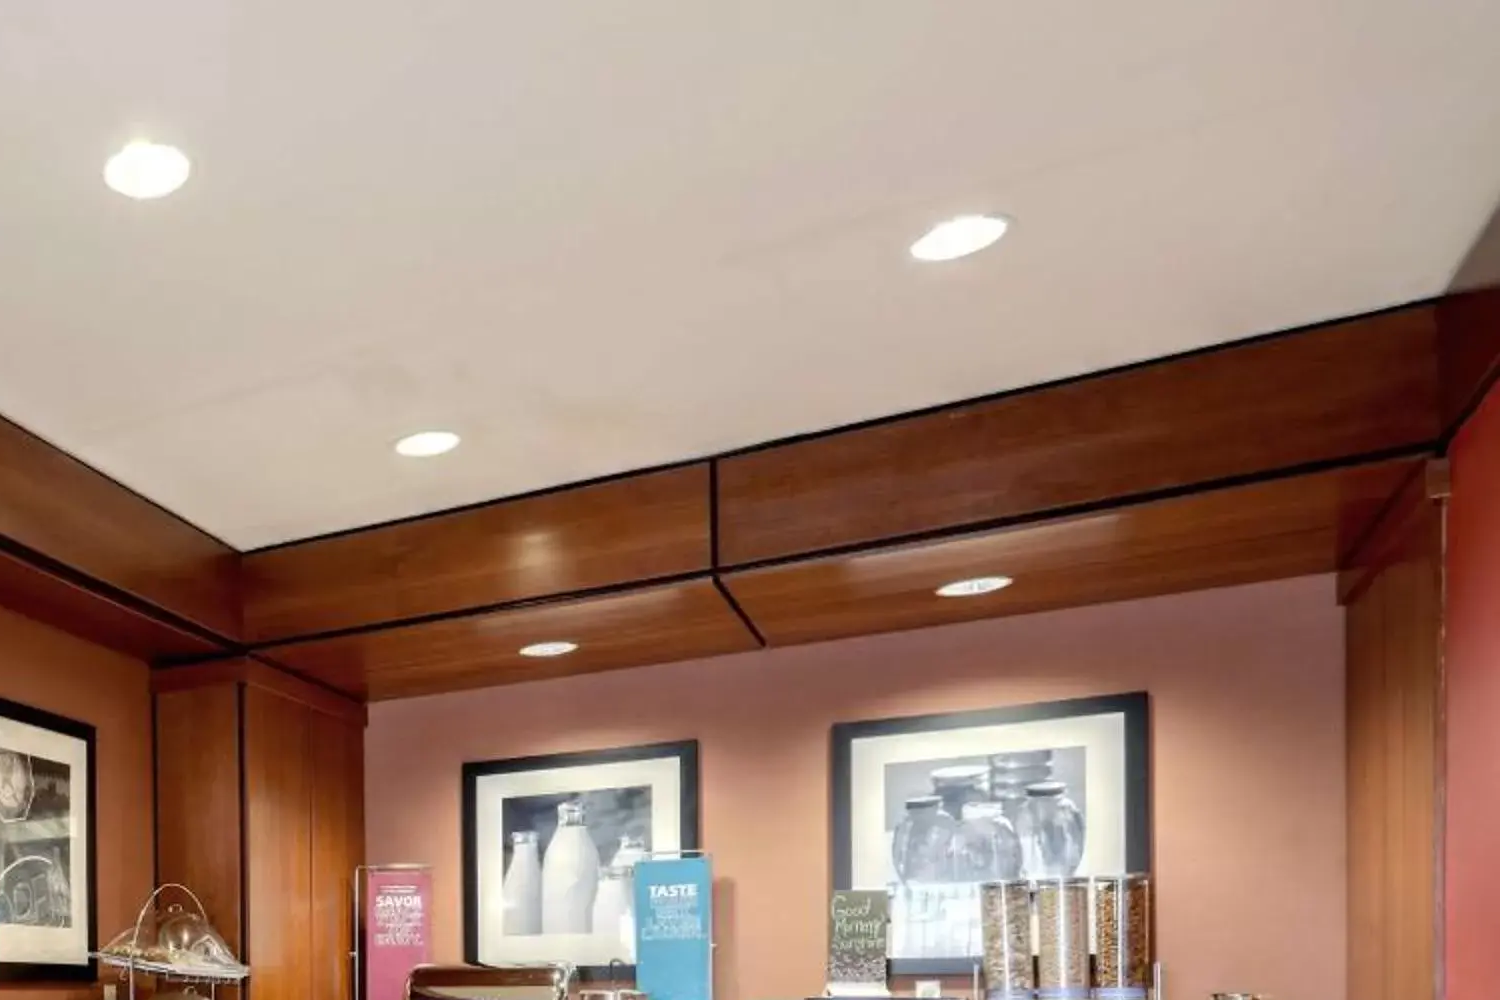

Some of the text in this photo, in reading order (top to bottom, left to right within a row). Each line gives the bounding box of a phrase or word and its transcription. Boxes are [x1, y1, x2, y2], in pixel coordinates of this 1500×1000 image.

[648, 884, 698, 898] TASTE
[375, 895, 422, 908] SAVOR
[831, 894, 872, 919] Good
